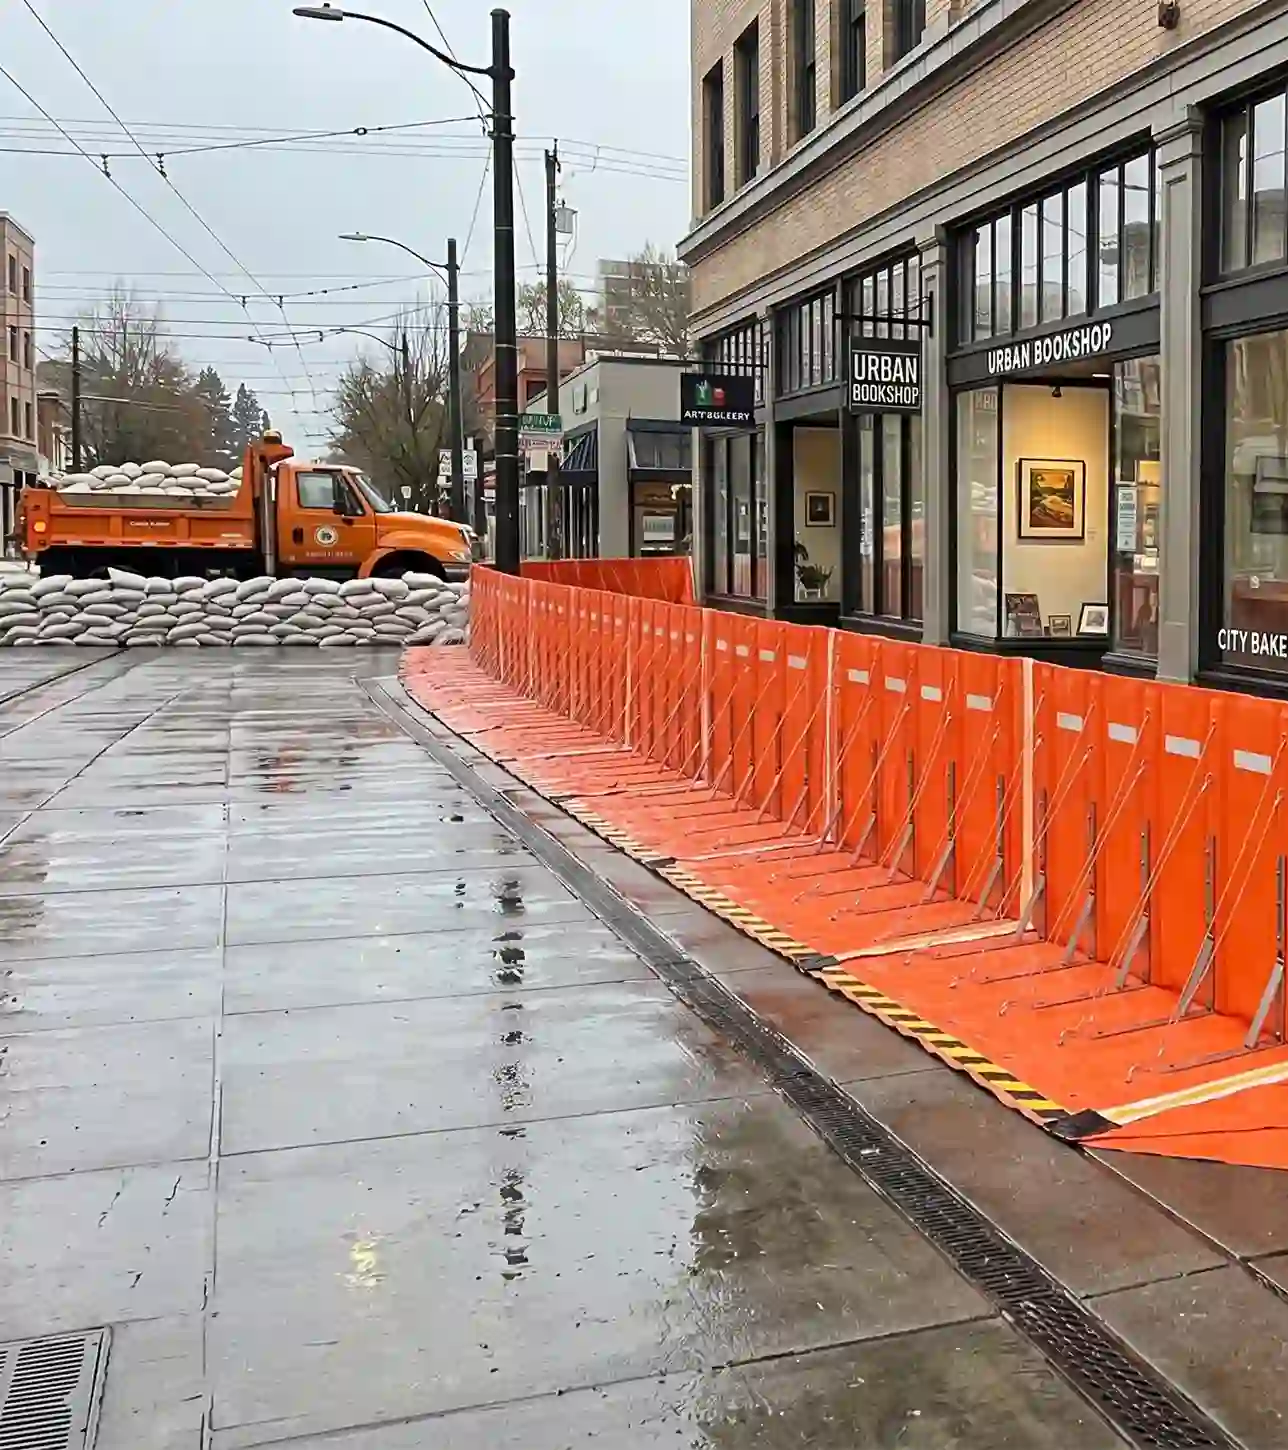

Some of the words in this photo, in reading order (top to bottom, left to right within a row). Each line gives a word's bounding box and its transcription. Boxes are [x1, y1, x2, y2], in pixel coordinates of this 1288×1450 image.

[988, 342, 1030, 374] URBAN
[1034, 323, 1112, 365] BOOKSHOP
[854, 353, 917, 384] URBAN
[852, 383, 919, 404] BOOKSHOP
[1217, 628, 1248, 653] CITY
